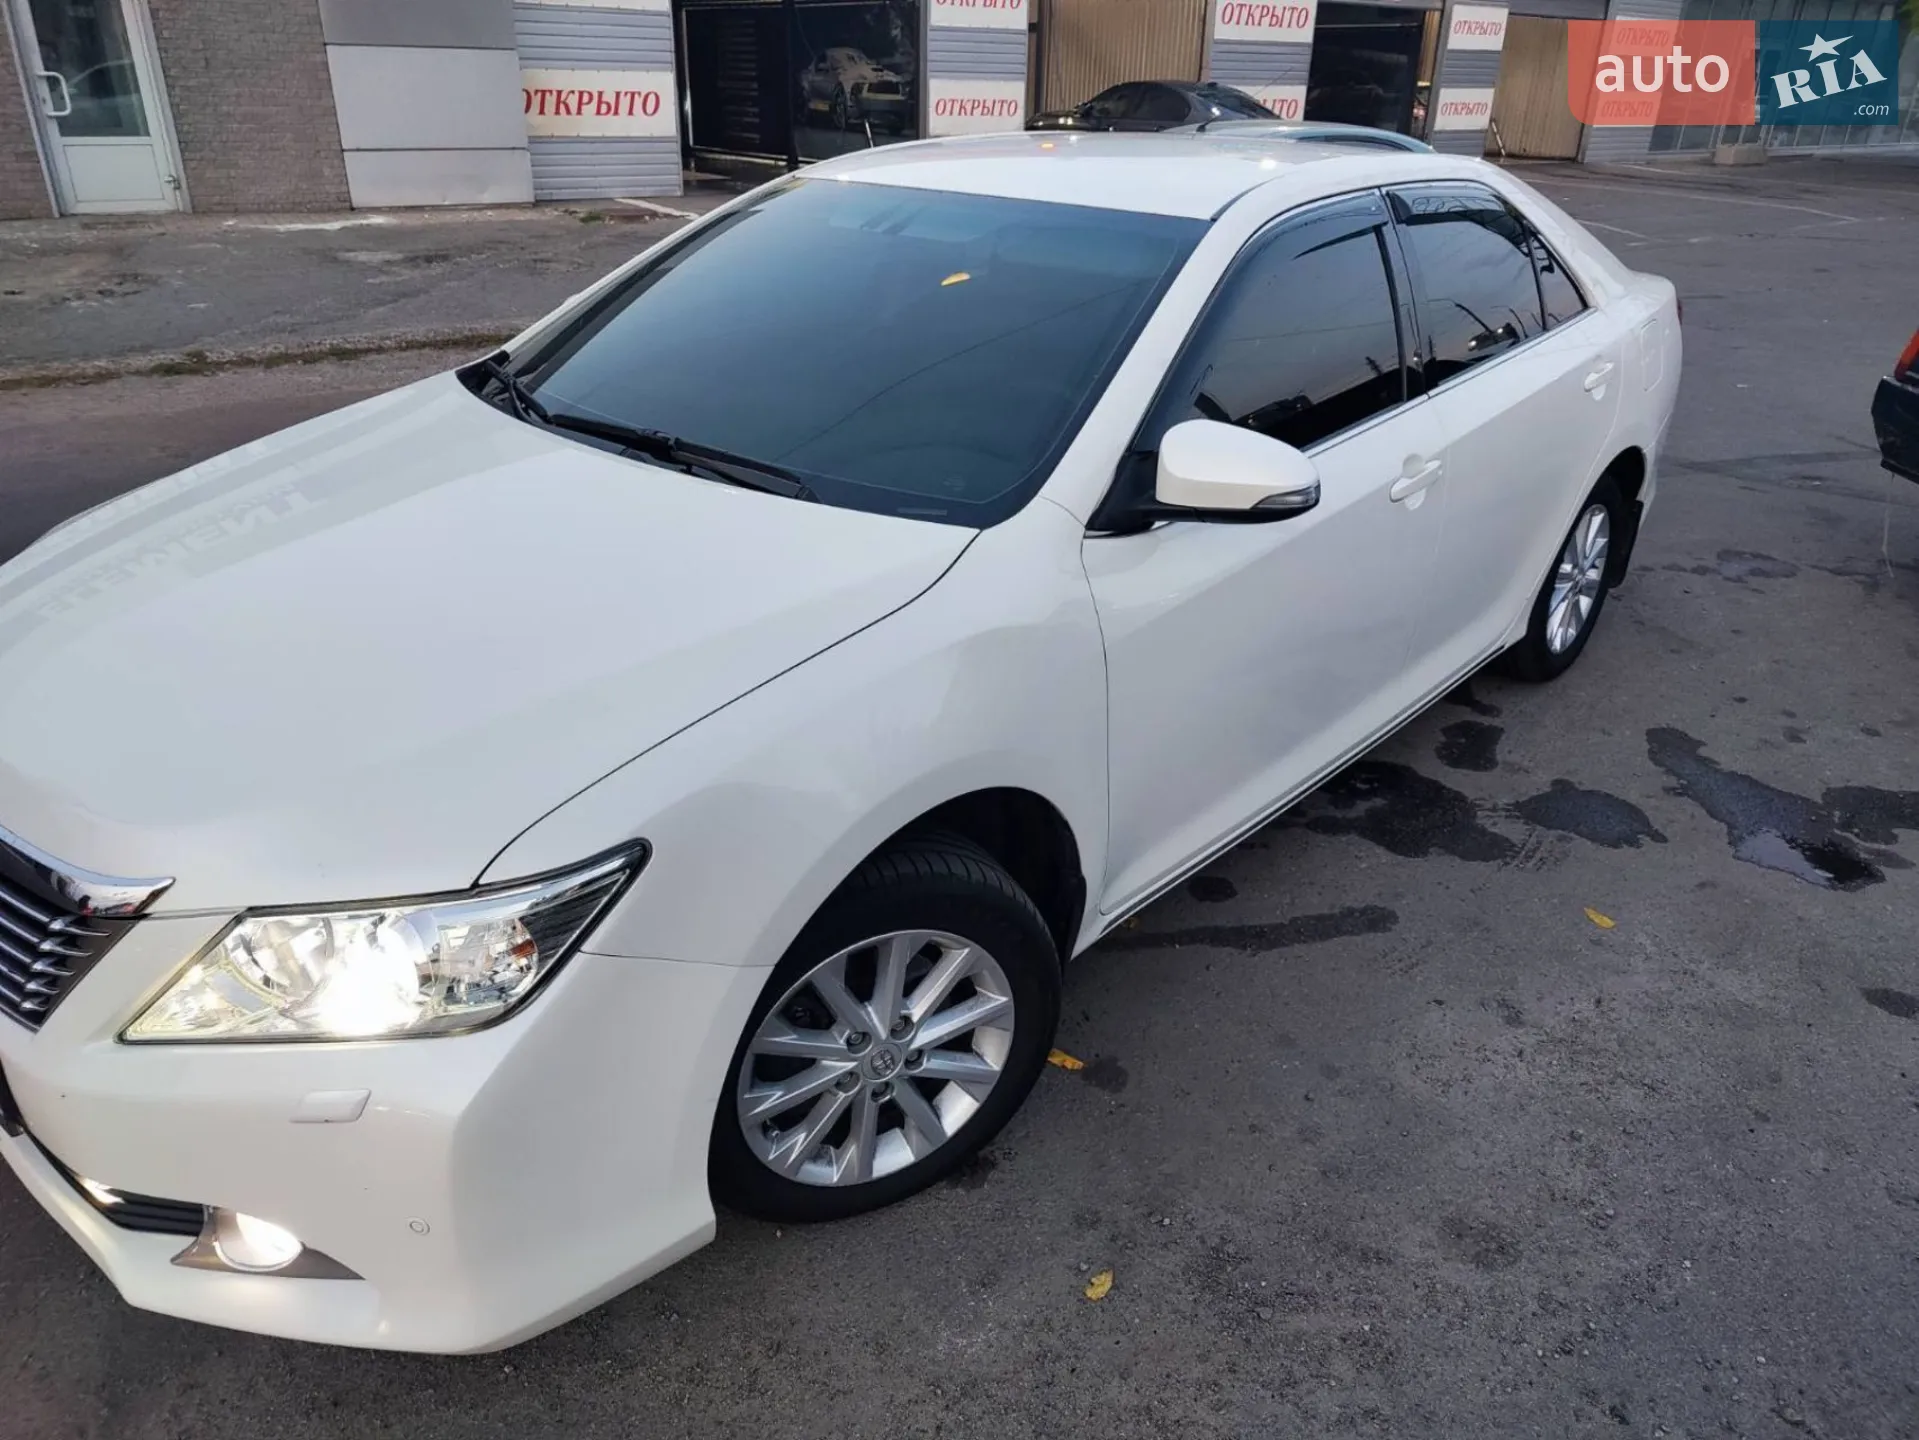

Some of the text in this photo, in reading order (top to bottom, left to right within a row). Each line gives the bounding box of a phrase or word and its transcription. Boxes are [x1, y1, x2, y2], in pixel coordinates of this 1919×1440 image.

[1221, 3, 1309, 28] ОТКРЫТО
[1454, 20, 1501, 36] ОТКРЫТО
[1616, 27, 1669, 46] ОТКРЫТО
[935, 98, 1018, 117] ОТКРЫТО
[1441, 102, 1488, 116] ОТКРЫТО
[1601, 100, 1654, 118] ОТКРЫТО
